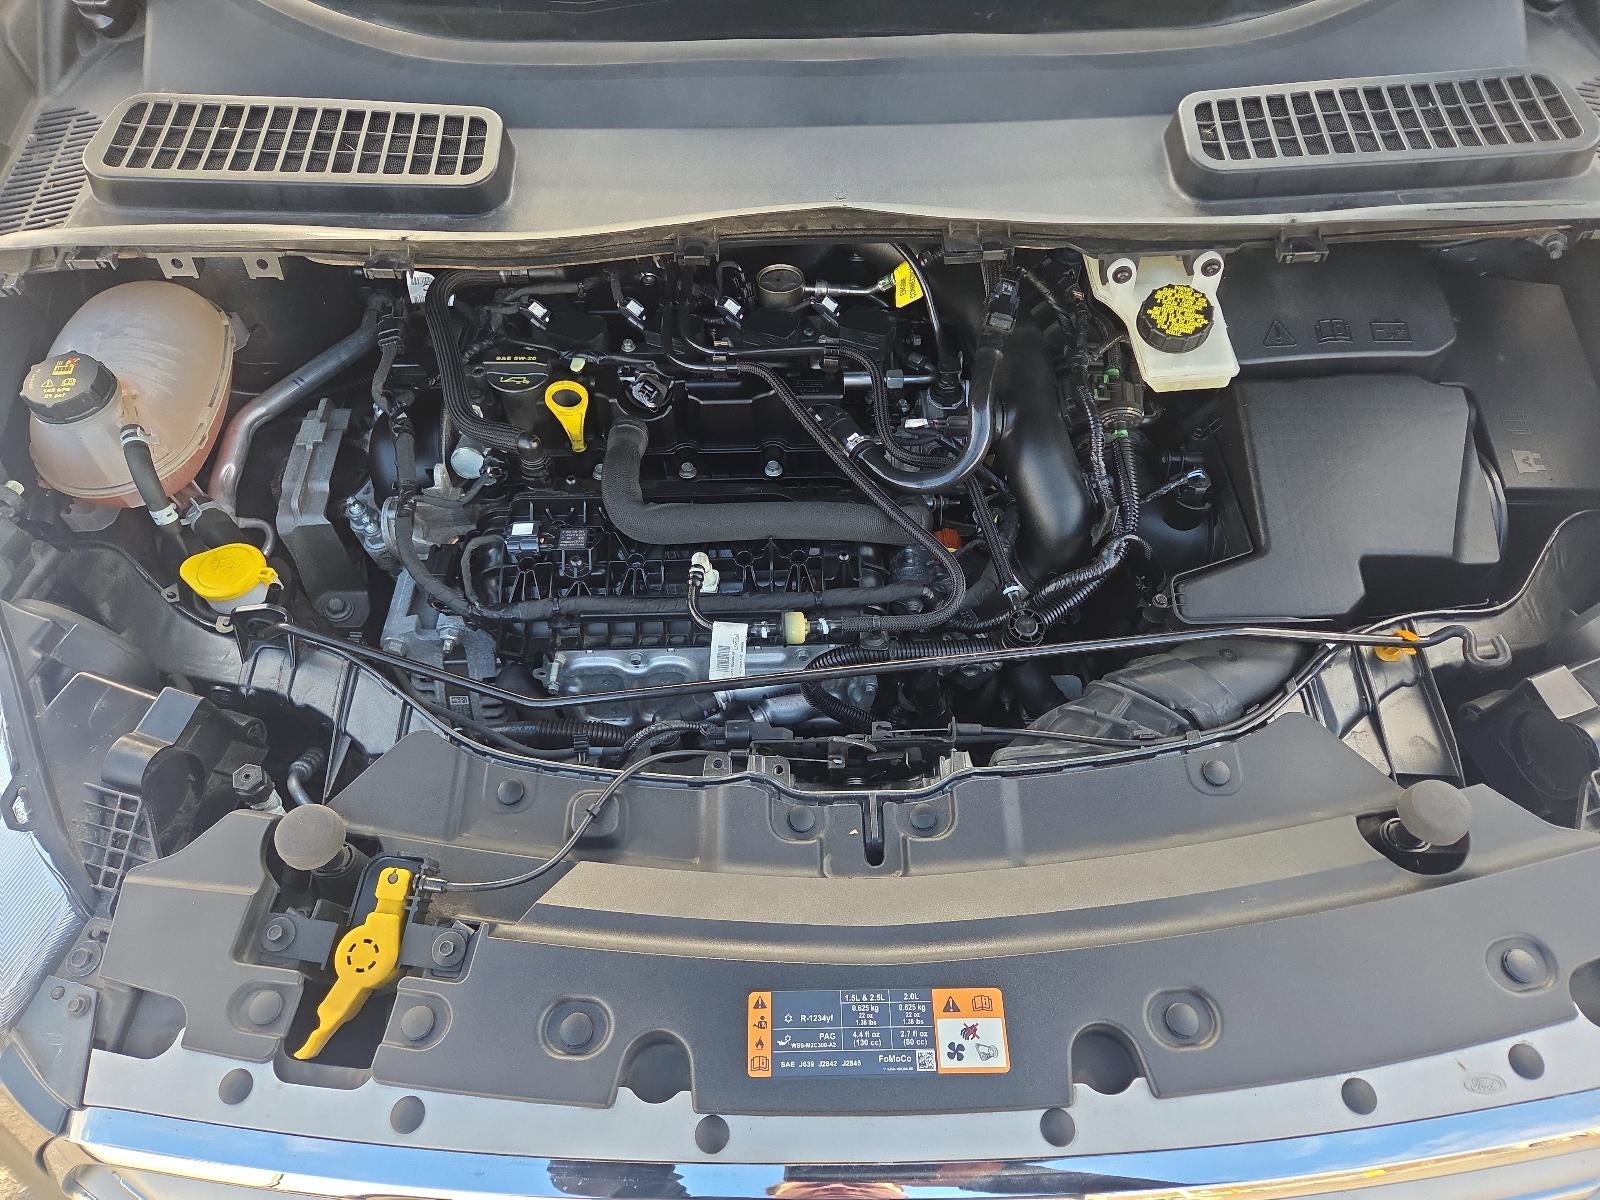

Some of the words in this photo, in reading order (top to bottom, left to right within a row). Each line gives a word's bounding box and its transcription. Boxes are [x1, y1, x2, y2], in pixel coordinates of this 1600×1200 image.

[845, 994, 861, 1002] 1.5L
[862, 993, 868, 1002] &
[870, 993, 886, 1002] 2.5L
[903, 992, 920, 1001] 2.0L
[851, 1004, 870, 1012] 0.625
[871, 1004, 880, 1013] kg
[898, 1003, 917, 1011] 0.625
[918, 1003, 926, 1013] kg
[800, 1014, 834, 1024] R-1234yf
[819, 1032, 836, 1040] PAG
[865, 1030, 870, 1038] fl
[853, 1039, 869, 1048] (130
[870, 1039, 882, 1047] cc)
[903, 1038, 915, 1047] (80
[916, 1038, 928, 1047] cc)
[878, 1054, 912, 1063] FoMoCo
[798, 1060, 815, 1068] J639
[841, 1059, 862, 1067] J2845
